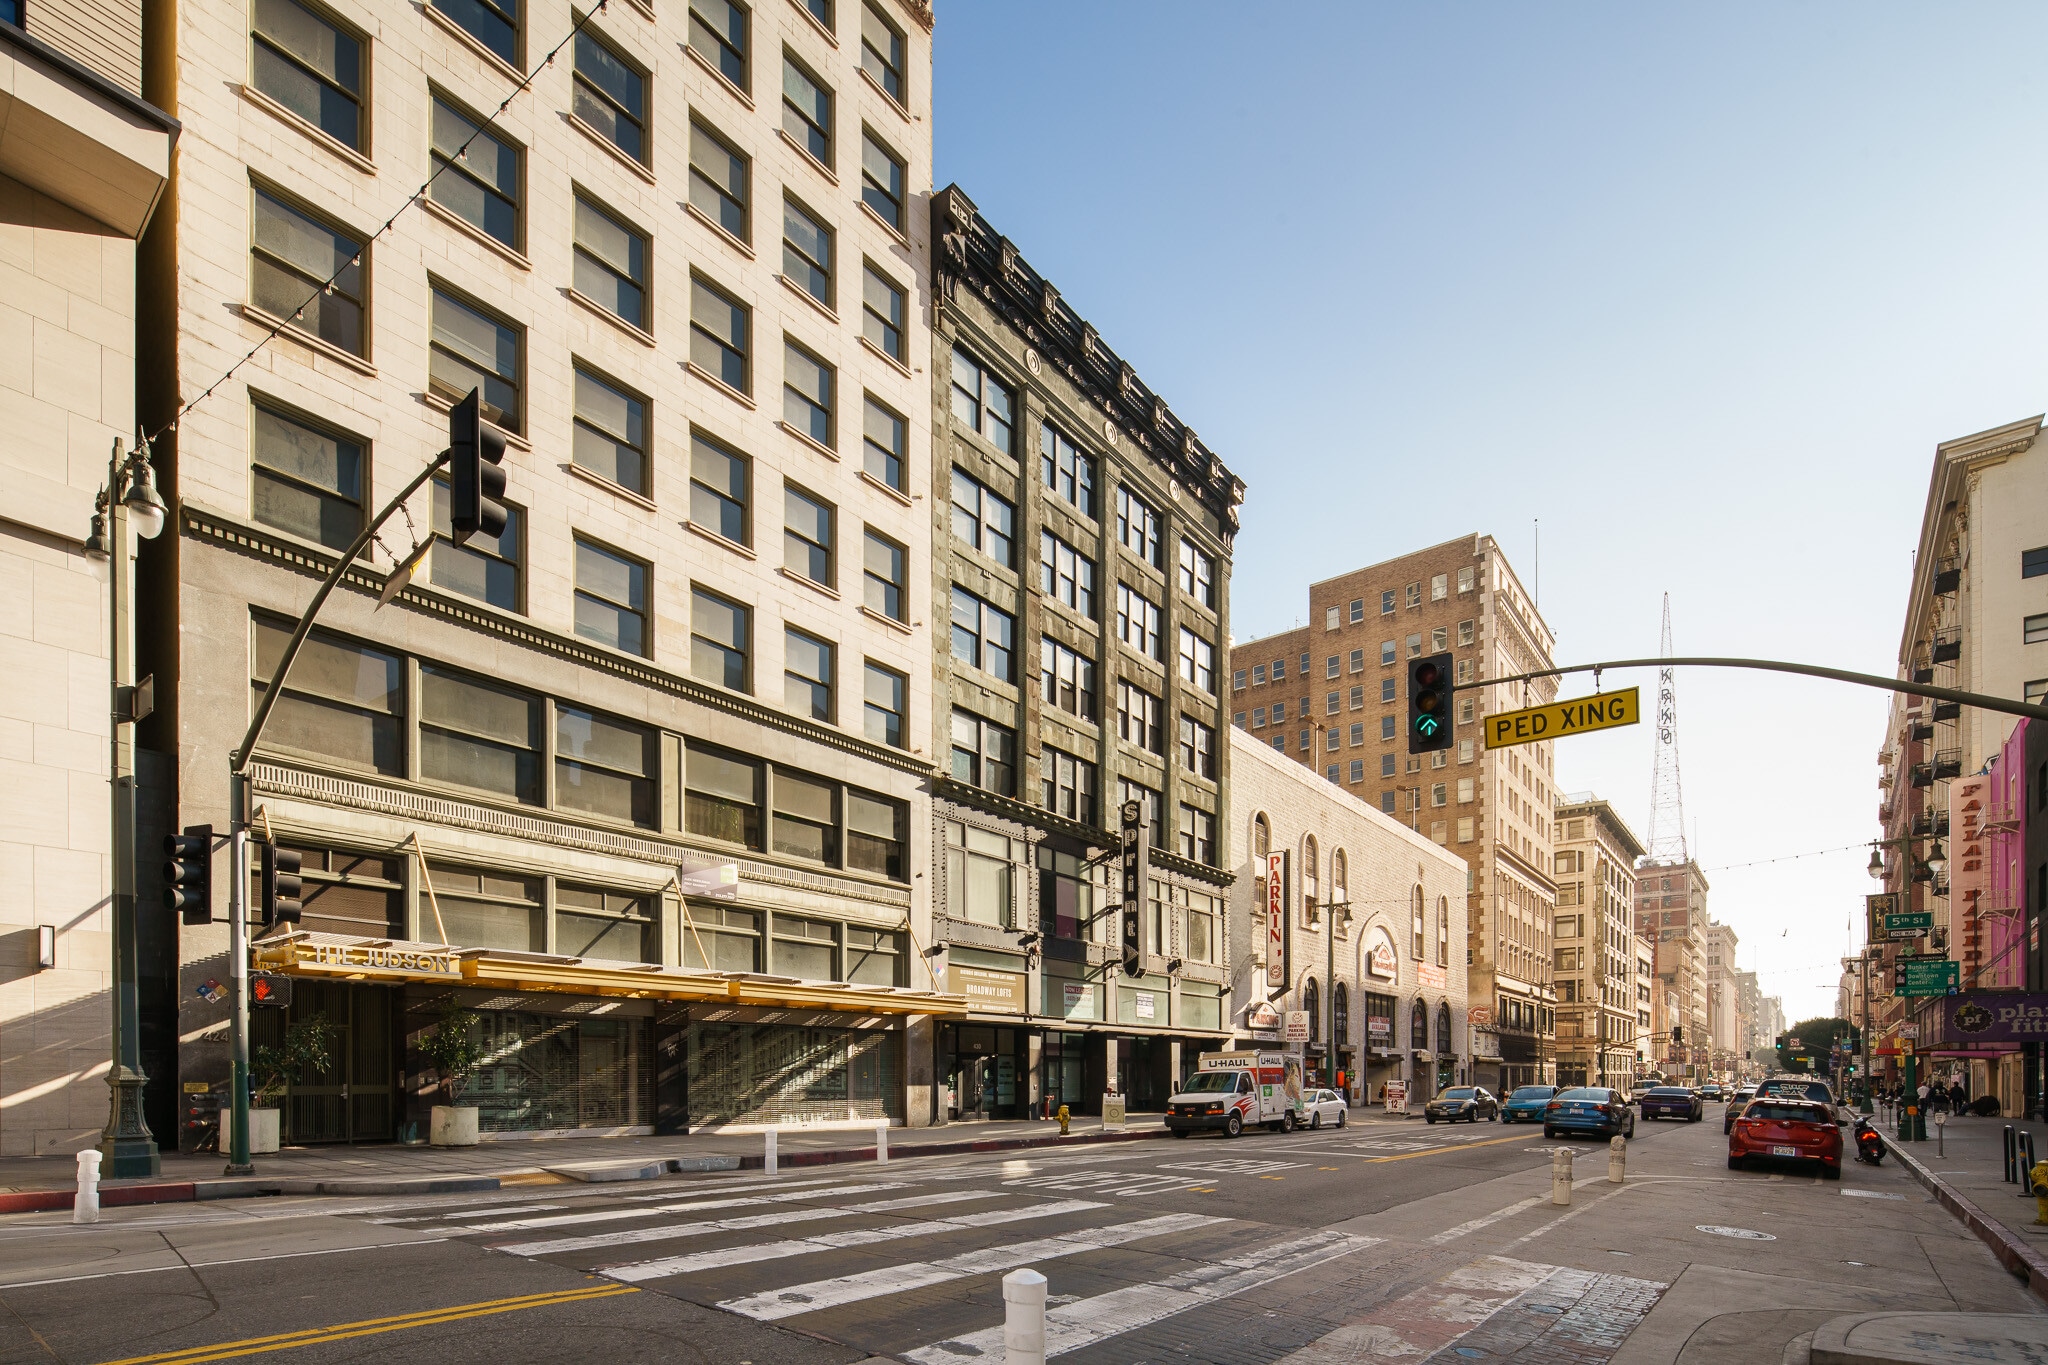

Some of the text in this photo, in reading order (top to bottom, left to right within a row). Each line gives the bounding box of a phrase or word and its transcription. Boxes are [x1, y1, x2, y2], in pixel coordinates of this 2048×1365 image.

[1496, 697, 1625, 742] PED XING
[1961, 784, 1982, 872] FALLAS
[1124, 804, 1138, 937] Sprint
[1269, 856, 1281, 957] PARKIN
[1892, 917, 1909, 926] 5th
[313, 945, 450, 973] THE JUDSON
[966, 984, 1012, 998] BROADWAY LOFTS
[1963, 1014, 1983, 1026] pf
[1998, 1003, 2048, 1023] pla
[2010, 1018, 2048, 1033] fit
[203, 1030, 229, 1042] 424
[1208, 1058, 1249, 1068] U-HAUL
[1260, 1057, 1282, 1065] U-HAUL
